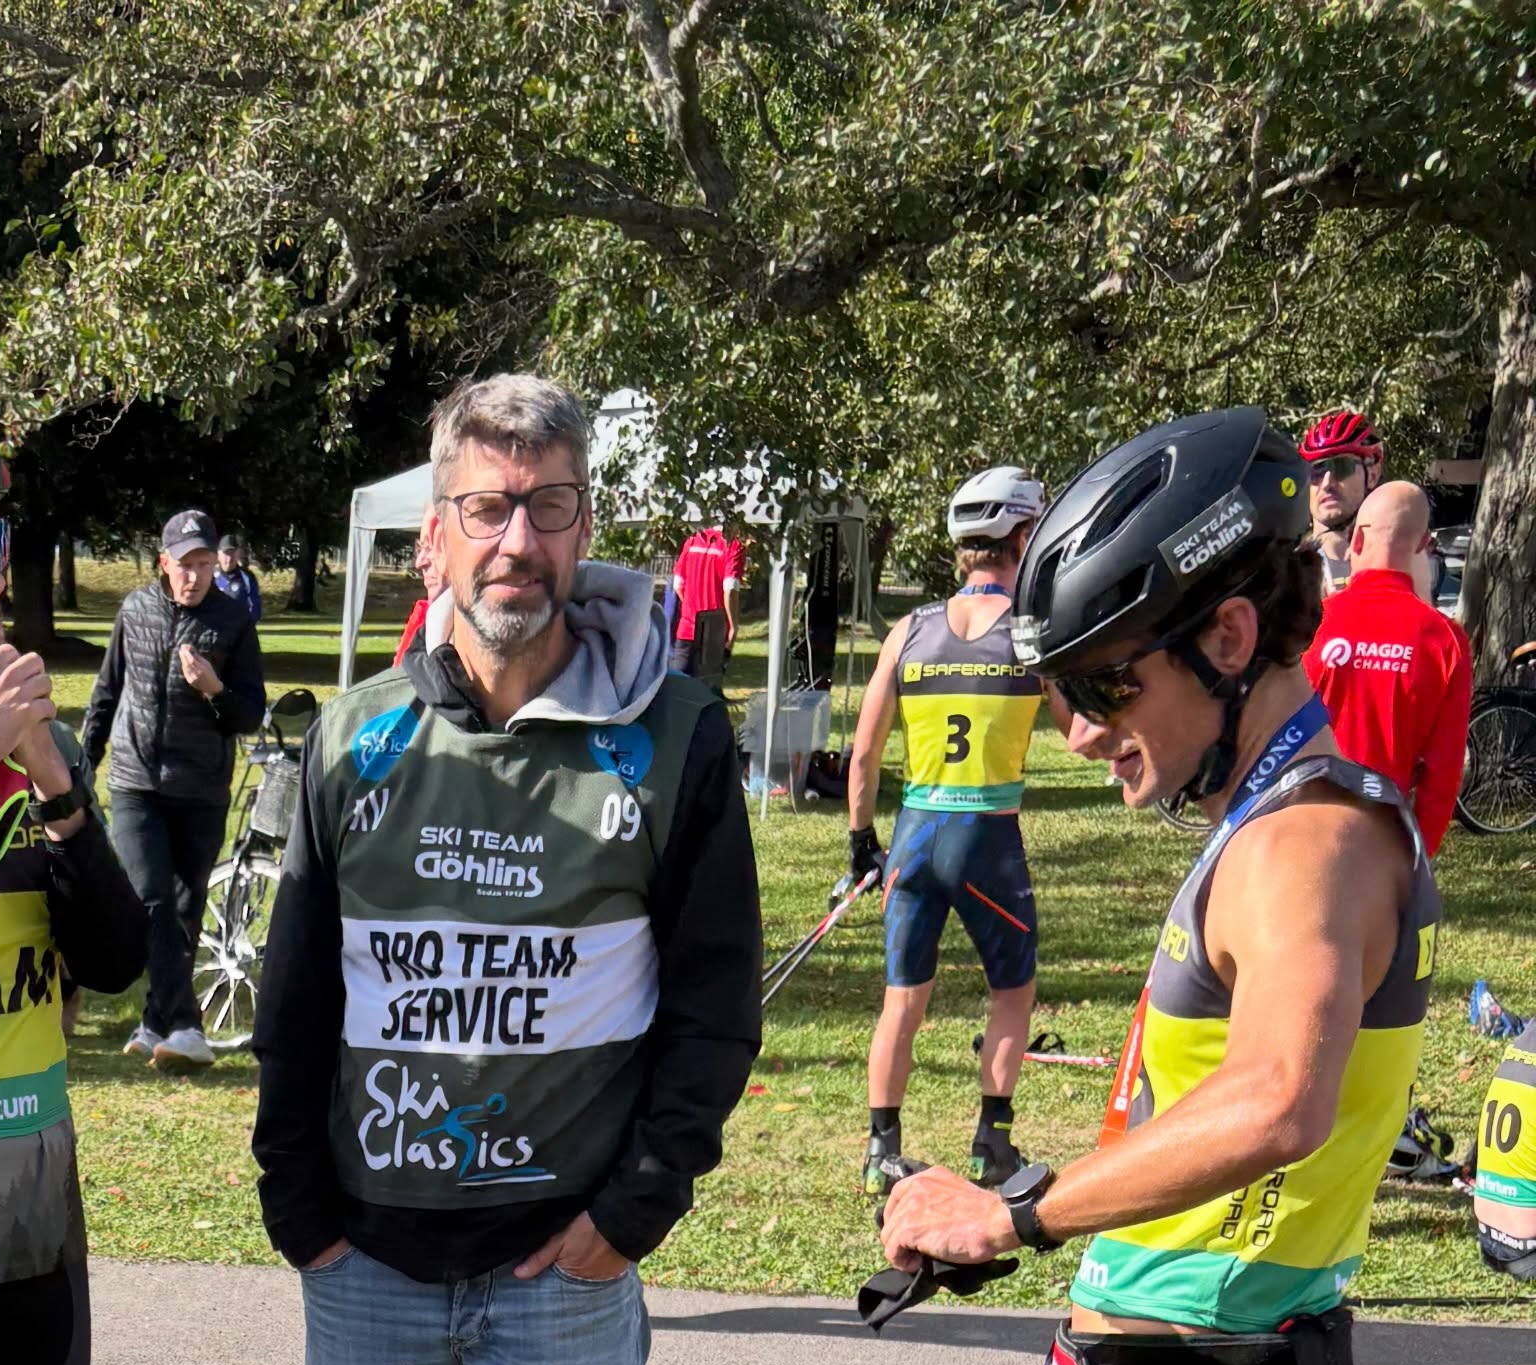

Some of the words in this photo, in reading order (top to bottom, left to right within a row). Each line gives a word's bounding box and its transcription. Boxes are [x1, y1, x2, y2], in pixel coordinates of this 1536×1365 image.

[1173, 533, 1201, 558] SKI
[1200, 502, 1243, 536] TEAM
[922, 663, 1027, 678] SAFEROAD
[1353, 659, 1409, 673] CHARGE
[1355, 641, 1414, 660] RAGDE
[944, 714, 971, 763] 3
[1244, 726, 1303, 792] KONG
[419, 826, 462, 847] SKI
[469, 829, 544, 853] TEAM
[599, 793, 641, 842] 09
[370, 930, 444, 984] PRO
[457, 932, 577, 979] TEAM
[381, 986, 548, 1045] SERVICE
[366, 1059, 450, 1128] Ski
[1485, 1099, 1522, 1154] 10
